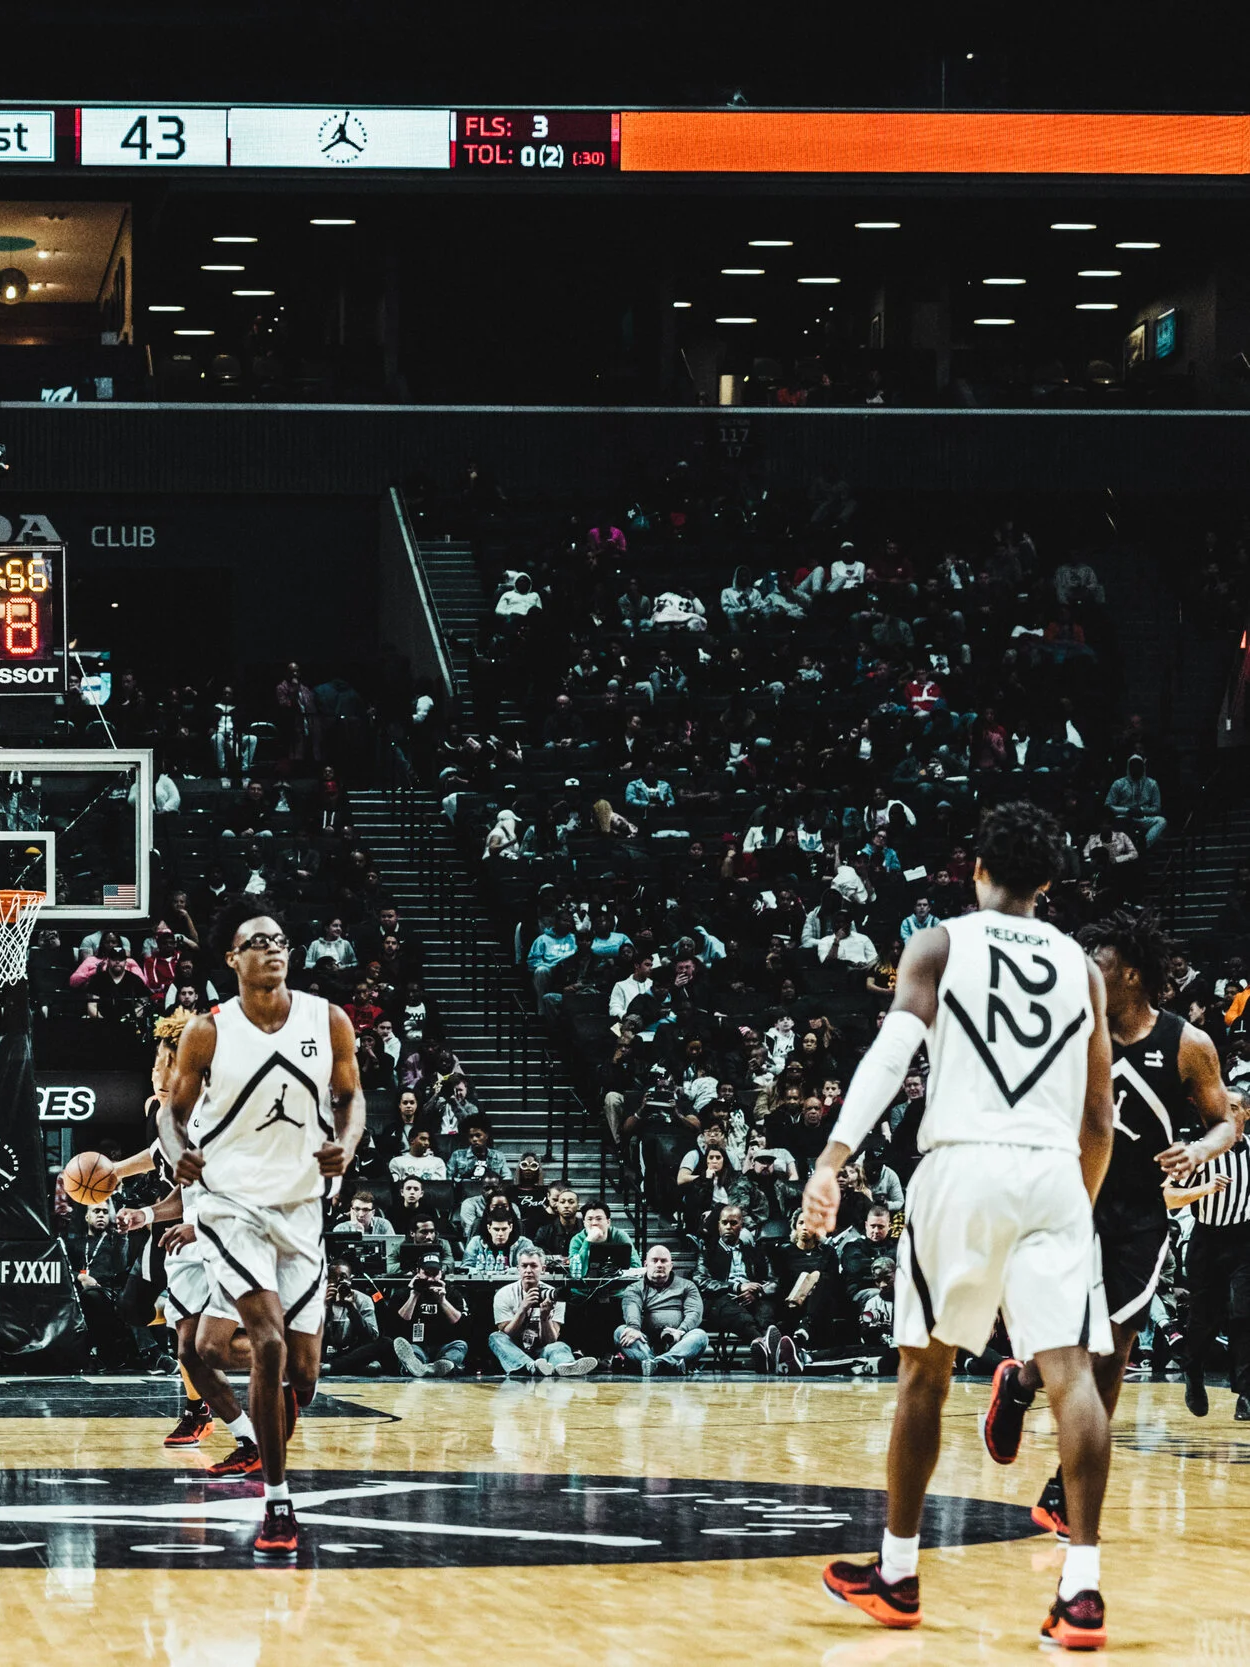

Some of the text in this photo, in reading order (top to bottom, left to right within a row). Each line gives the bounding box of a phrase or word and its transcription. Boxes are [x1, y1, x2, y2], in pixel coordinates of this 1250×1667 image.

[120, 115, 186, 160] 43
[465, 116, 549, 138] FLS: 3
[463, 144, 513, 165] TOL:
[572, 151, 605, 167] (:30)
[719, 428, 749, 442] 117
[91, 526, 156, 547] CLUB
[985, 926, 1050, 946] REDDISH
[987, 944, 1058, 1049] 22
[300, 1037, 318, 1058] 15
[1143, 1049, 1165, 1068] 11
[3, 1144, 19, 1171] BRAND
[517, 1195, 547, 1207] Bad
[12, 1261, 61, 1284] XXXII
